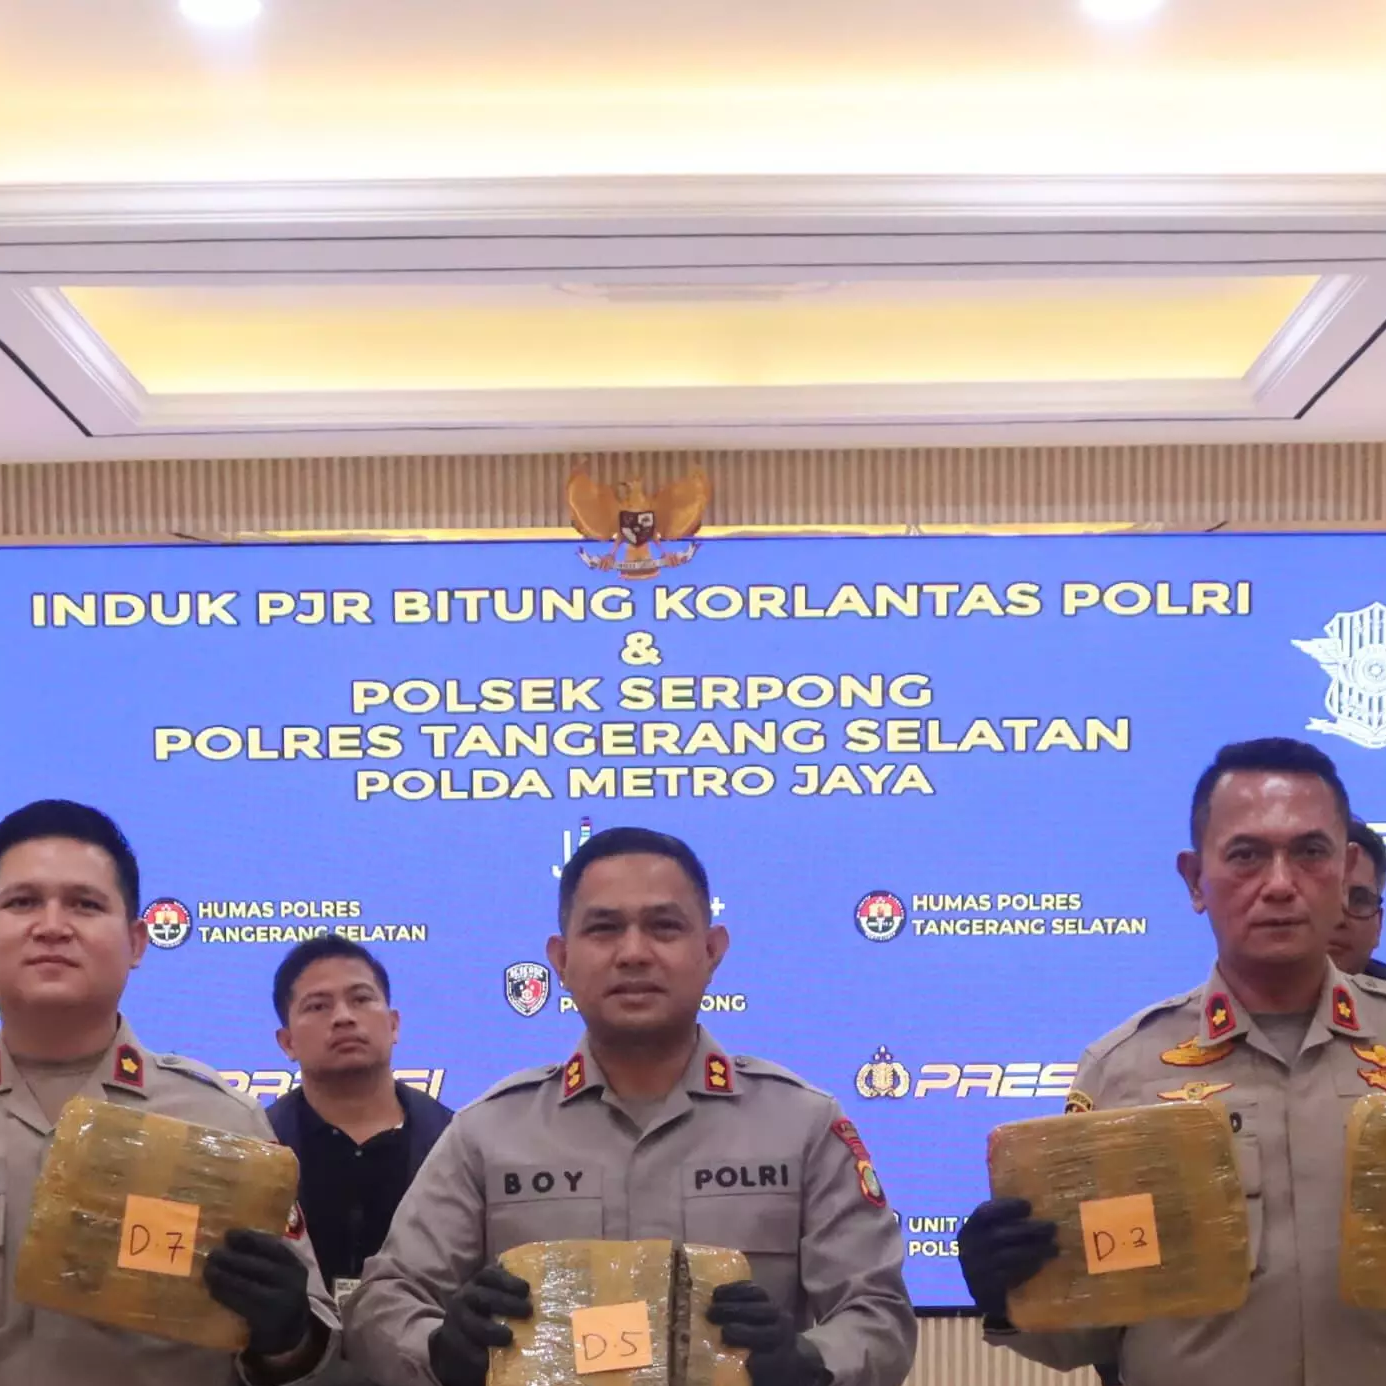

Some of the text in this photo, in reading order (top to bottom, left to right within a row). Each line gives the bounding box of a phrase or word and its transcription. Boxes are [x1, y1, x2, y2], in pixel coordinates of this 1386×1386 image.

[32, 582, 1250, 626] INDUK PJR BITUNG KORLANTAS POLRI
[621, 631, 662, 665] &
[353, 674, 931, 713] POLSEK SERPONG
[155, 718, 1129, 760] POLRES TANGERANG SELATAN
[357, 764, 934, 800] POLDA METRO JAYA
[198, 901, 270, 919] HUMAS
[270, 900, 360, 918] POLRES
[912, 893, 1081, 912] HUMAS POLRES
[196, 921, 429, 947] TANGERANG SELATAN
[911, 918, 1146, 936] TANGERANG SELATAN
[504, 1171, 583, 1196] BOY
[695, 1163, 794, 1195] POLRI
[907, 1216, 959, 1233] UNIT
